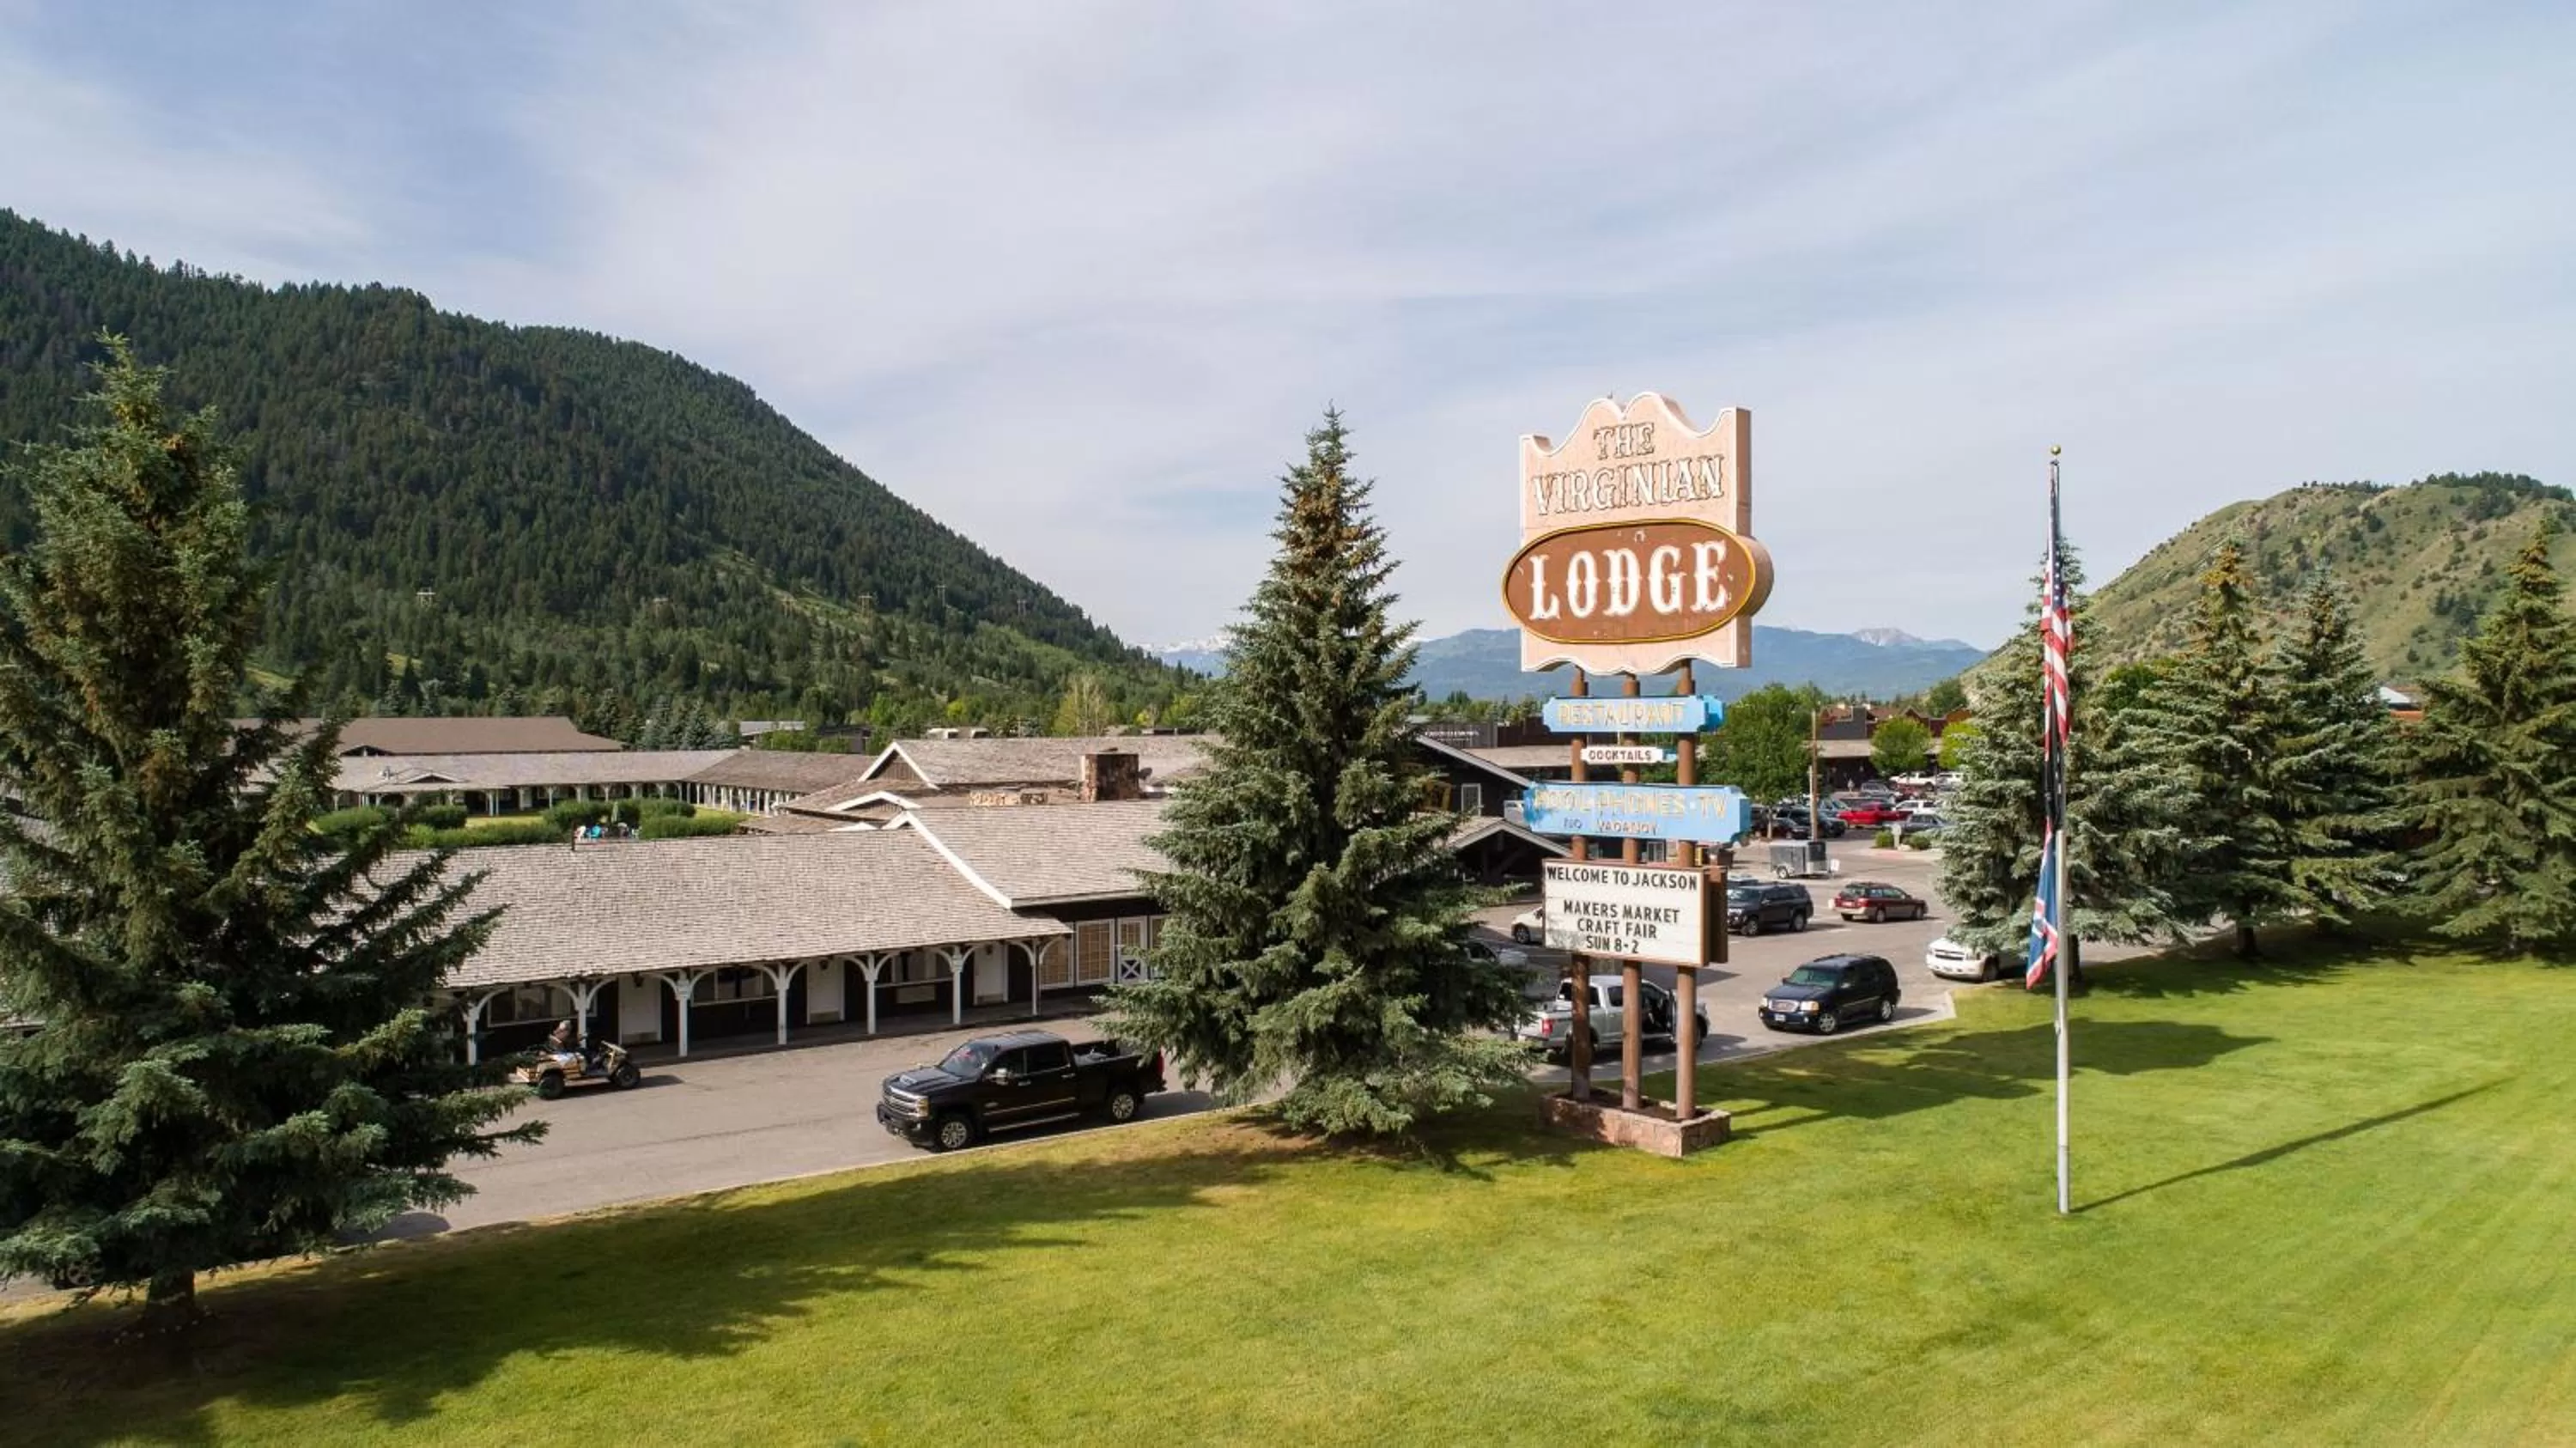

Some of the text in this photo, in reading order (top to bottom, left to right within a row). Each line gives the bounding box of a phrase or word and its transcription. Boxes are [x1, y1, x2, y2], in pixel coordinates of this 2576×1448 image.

[1593, 422, 1655, 460] THE
[1533, 454, 1725, 516] VIRGINIAN
[1528, 539, 1728, 620] LODGE
[1558, 701, 1686, 727] RESTAURANT
[1589, 749, 1652, 761] COCKTAILS
[1564, 818, 1583, 830] NO
[1546, 867, 1698, 891] WELCOME TO JACKSON
[1564, 899, 1680, 924] MAKERS MARKET
[1577, 918, 1657, 939] CRAFT FAIR
[1586, 936, 1610, 951] SUN
